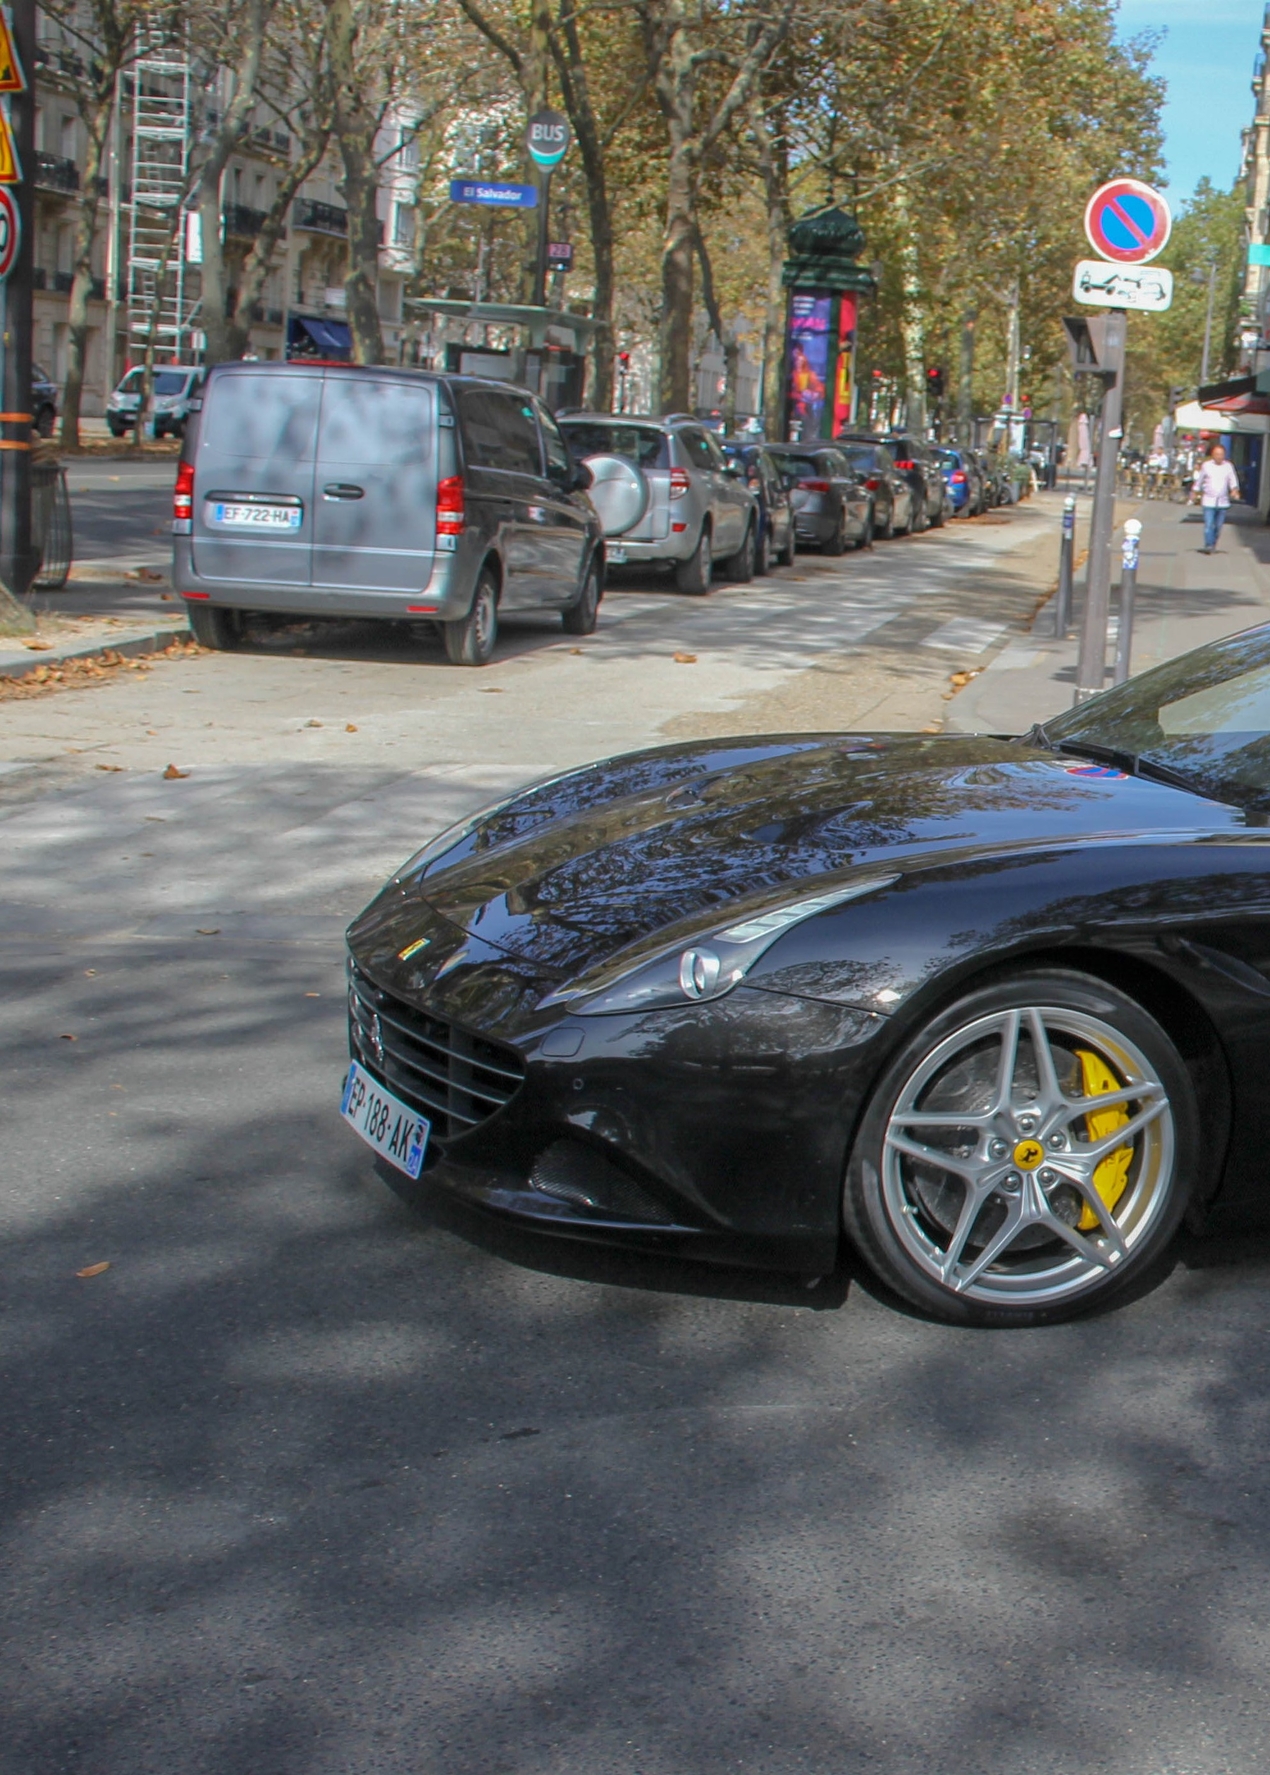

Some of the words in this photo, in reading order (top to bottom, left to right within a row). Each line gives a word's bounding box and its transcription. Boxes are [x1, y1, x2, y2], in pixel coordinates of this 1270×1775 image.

[531, 123, 564, 142] BUS
[463, 186, 475, 197] El
[476, 187, 522, 200] Salvador
[225, 507, 289, 523] EF-722-HA
